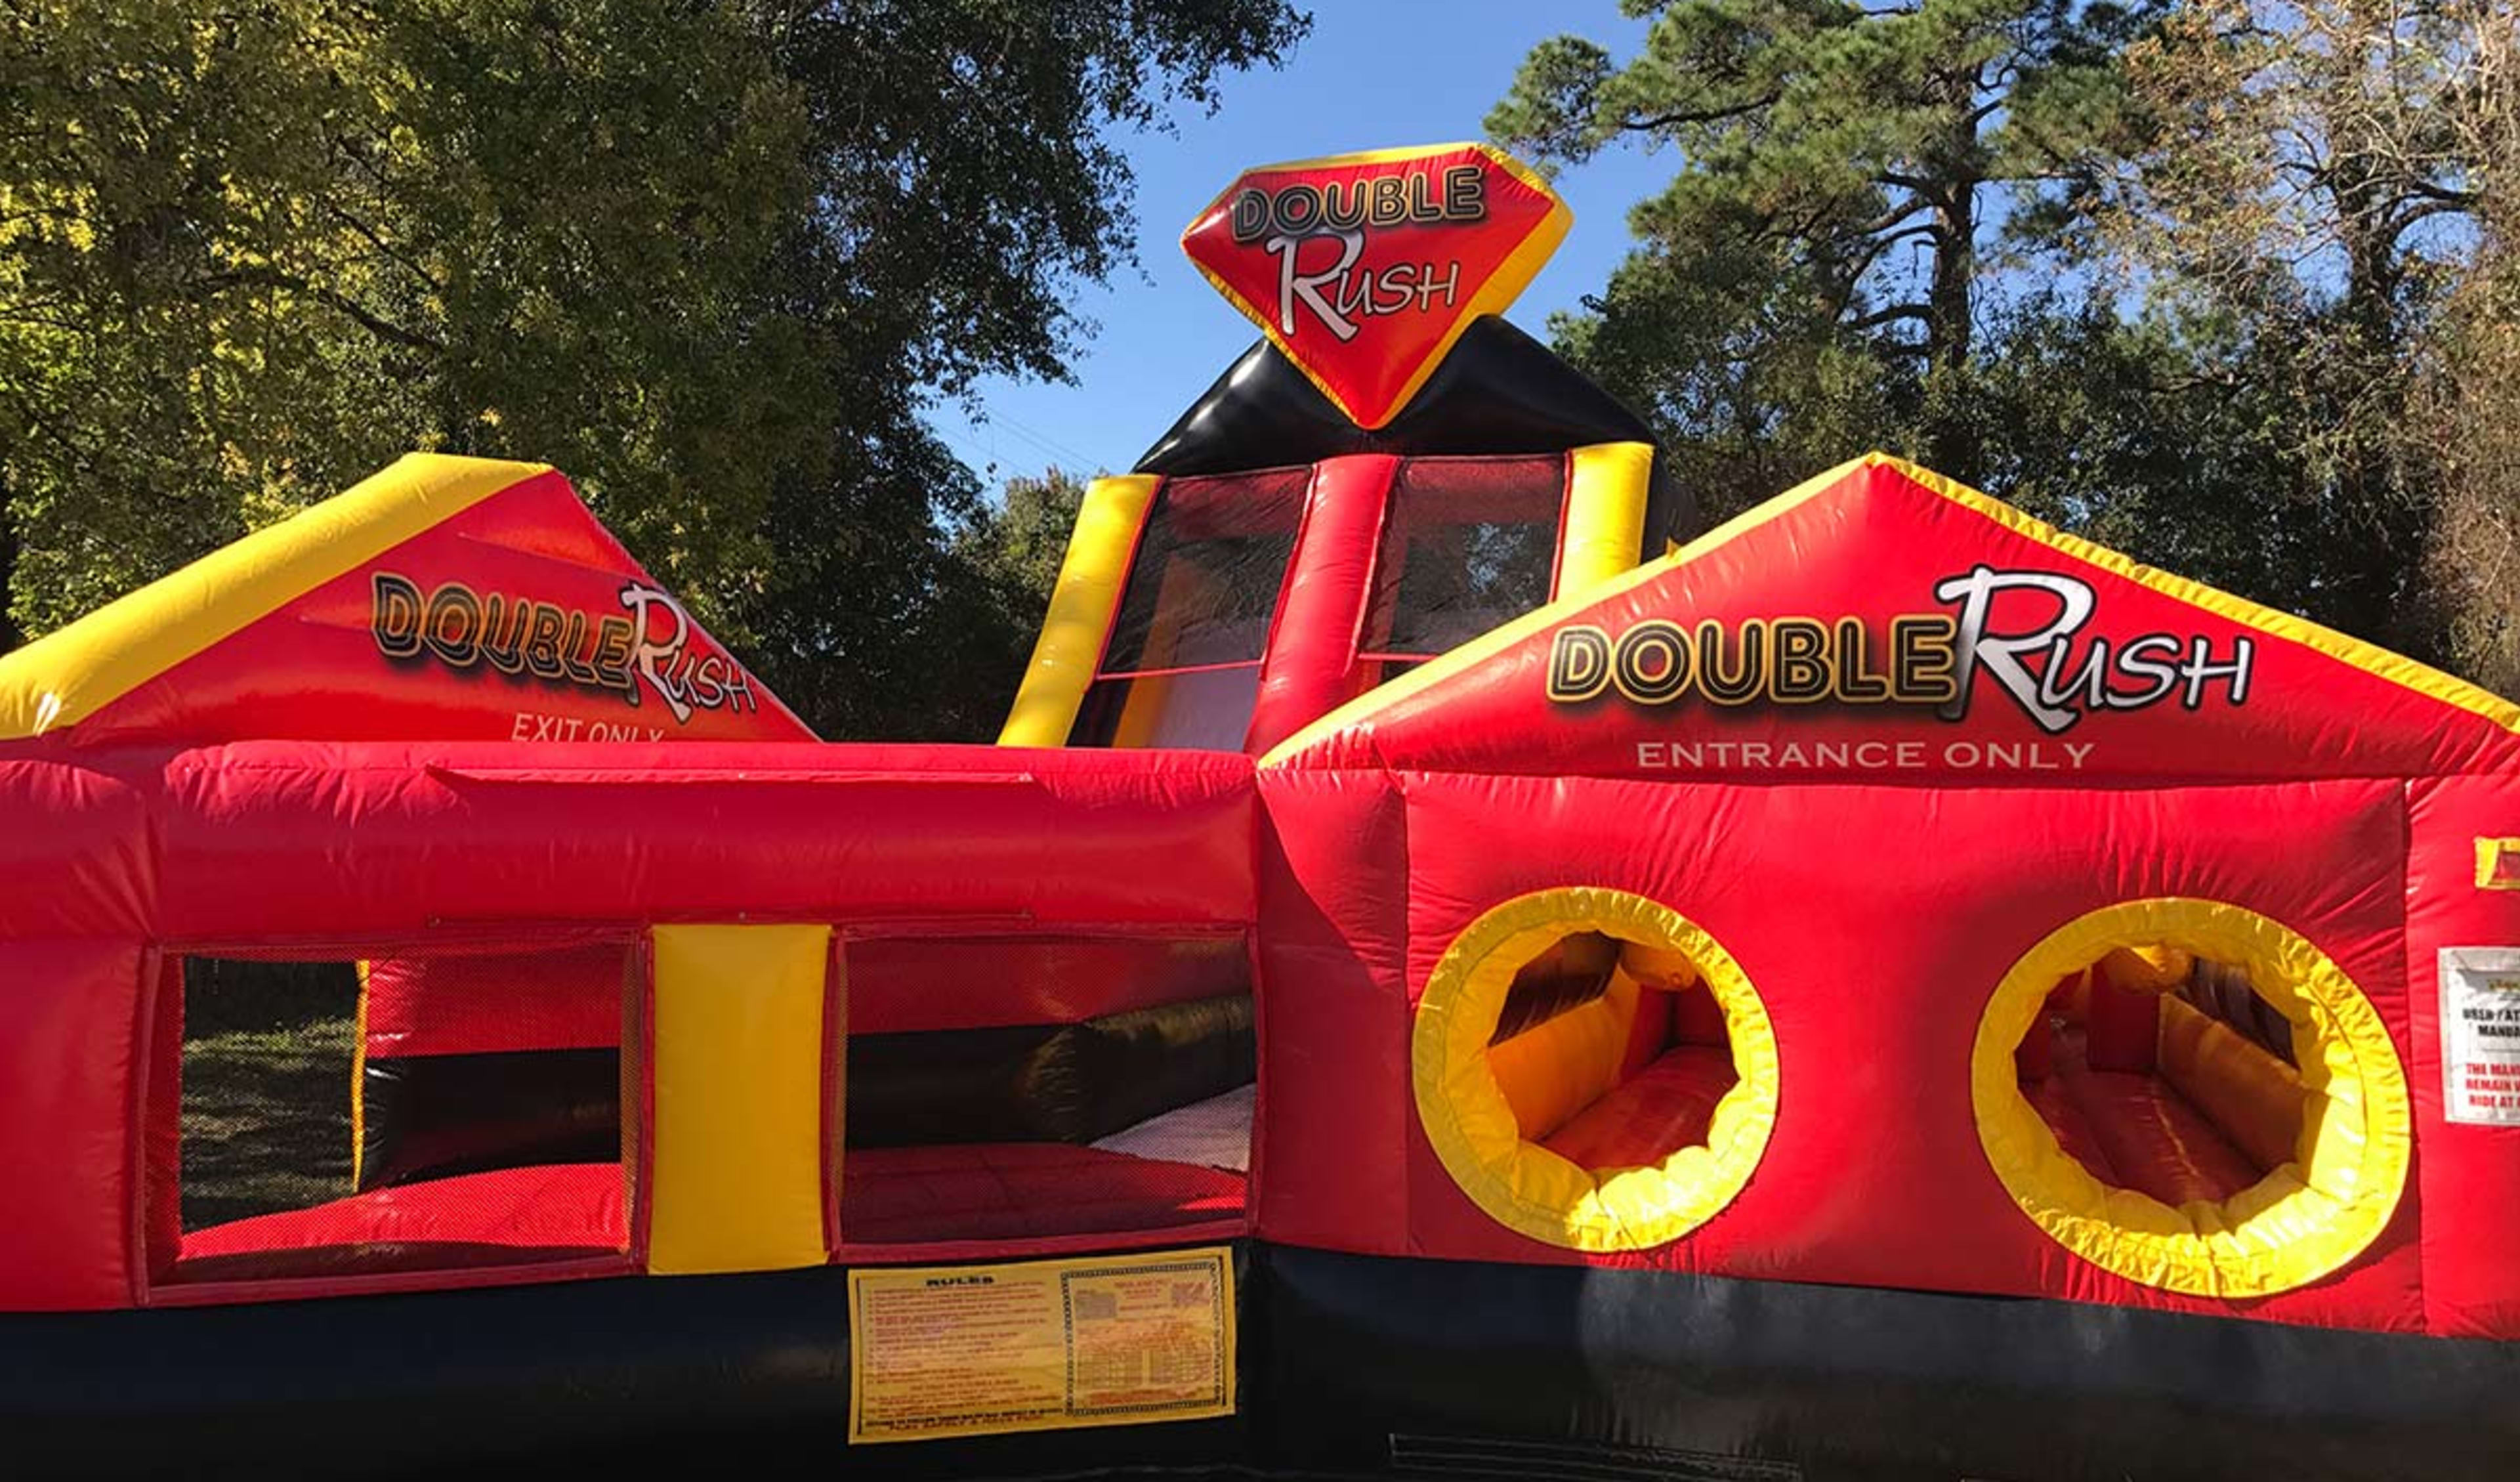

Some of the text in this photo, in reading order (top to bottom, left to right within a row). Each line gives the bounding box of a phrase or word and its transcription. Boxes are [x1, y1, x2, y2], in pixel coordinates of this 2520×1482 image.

[1232, 165, 1483, 242] DOUBLE
[371, 572, 635, 689] DOUBLE
[1546, 614, 1957, 706] DOUBLE
[512, 712, 583, 742] EXIT
[1637, 742, 2095, 769] ENTRANCE ONLY
